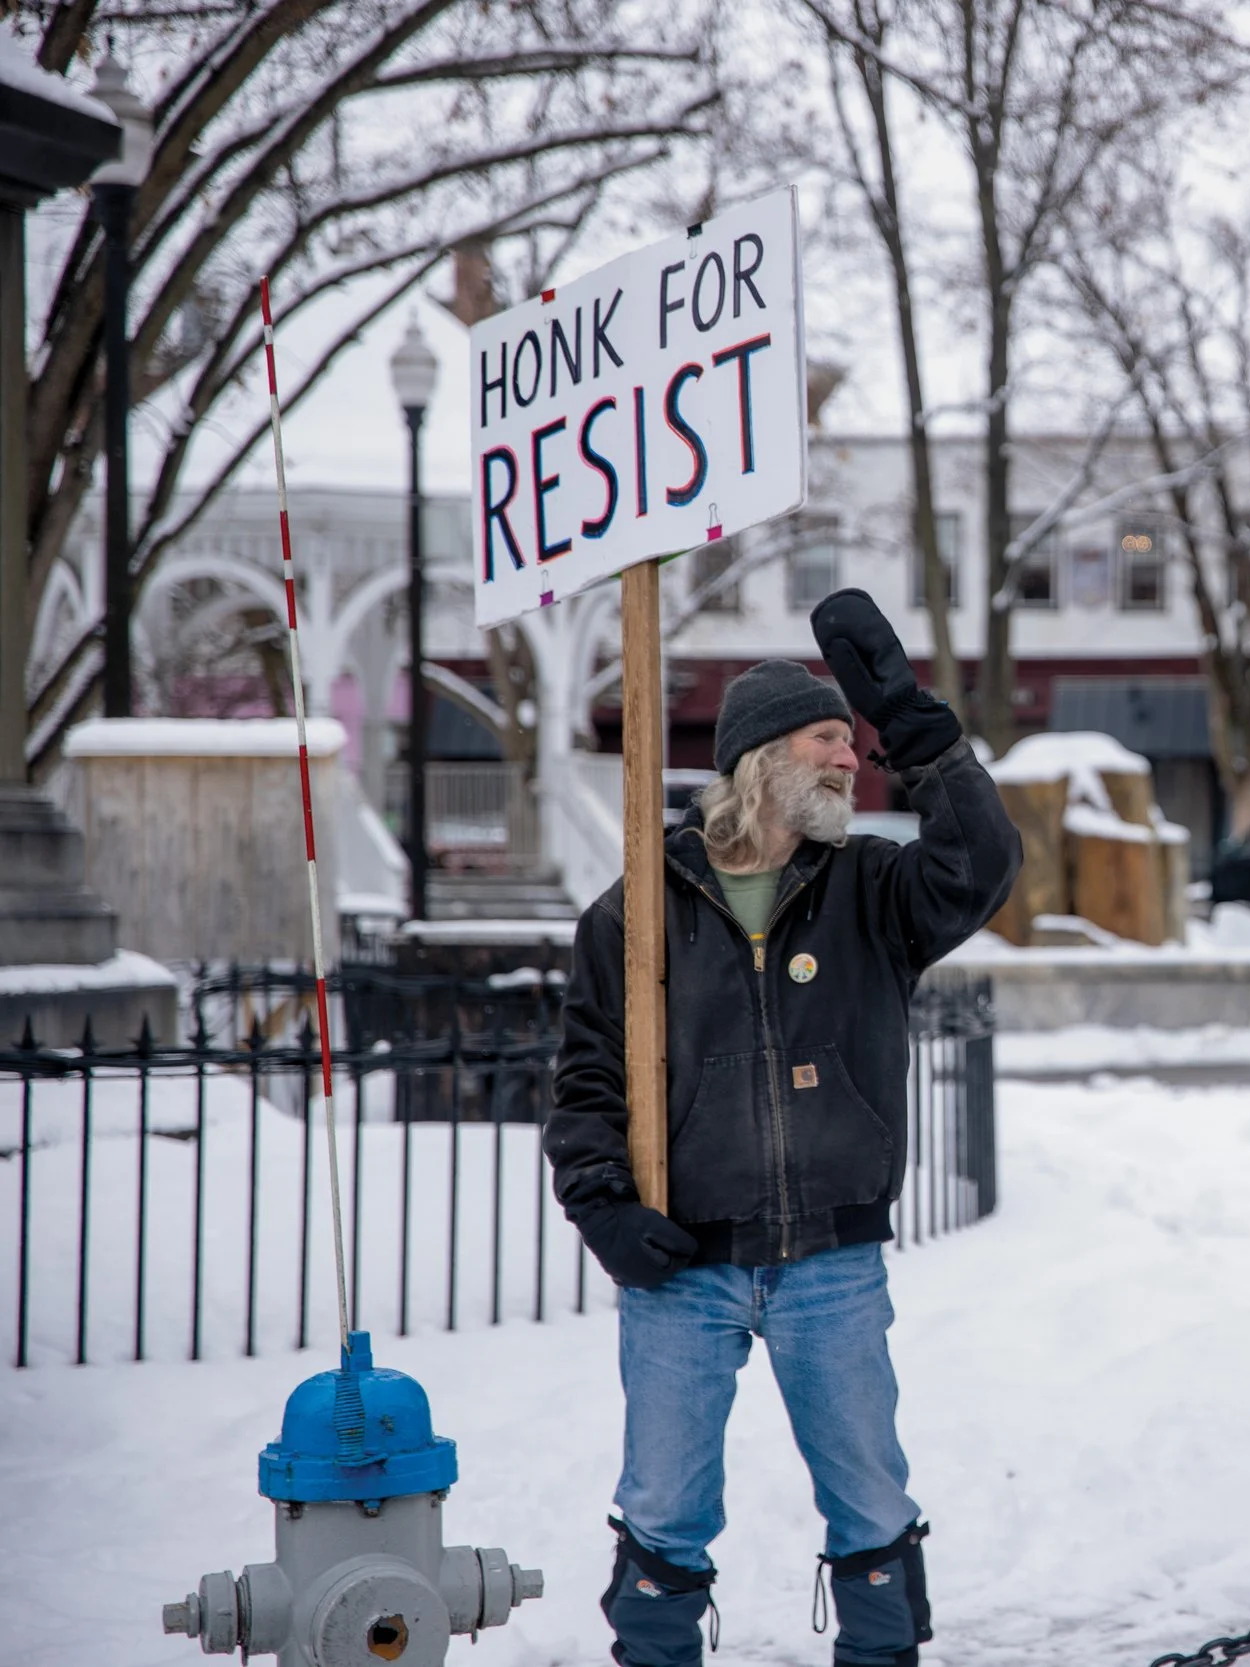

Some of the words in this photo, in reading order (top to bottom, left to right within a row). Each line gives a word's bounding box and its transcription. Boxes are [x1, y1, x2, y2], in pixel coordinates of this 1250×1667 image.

[481, 288, 624, 428] HONK
[660, 233, 767, 349] FOR
[480, 333, 772, 583] RESIST
